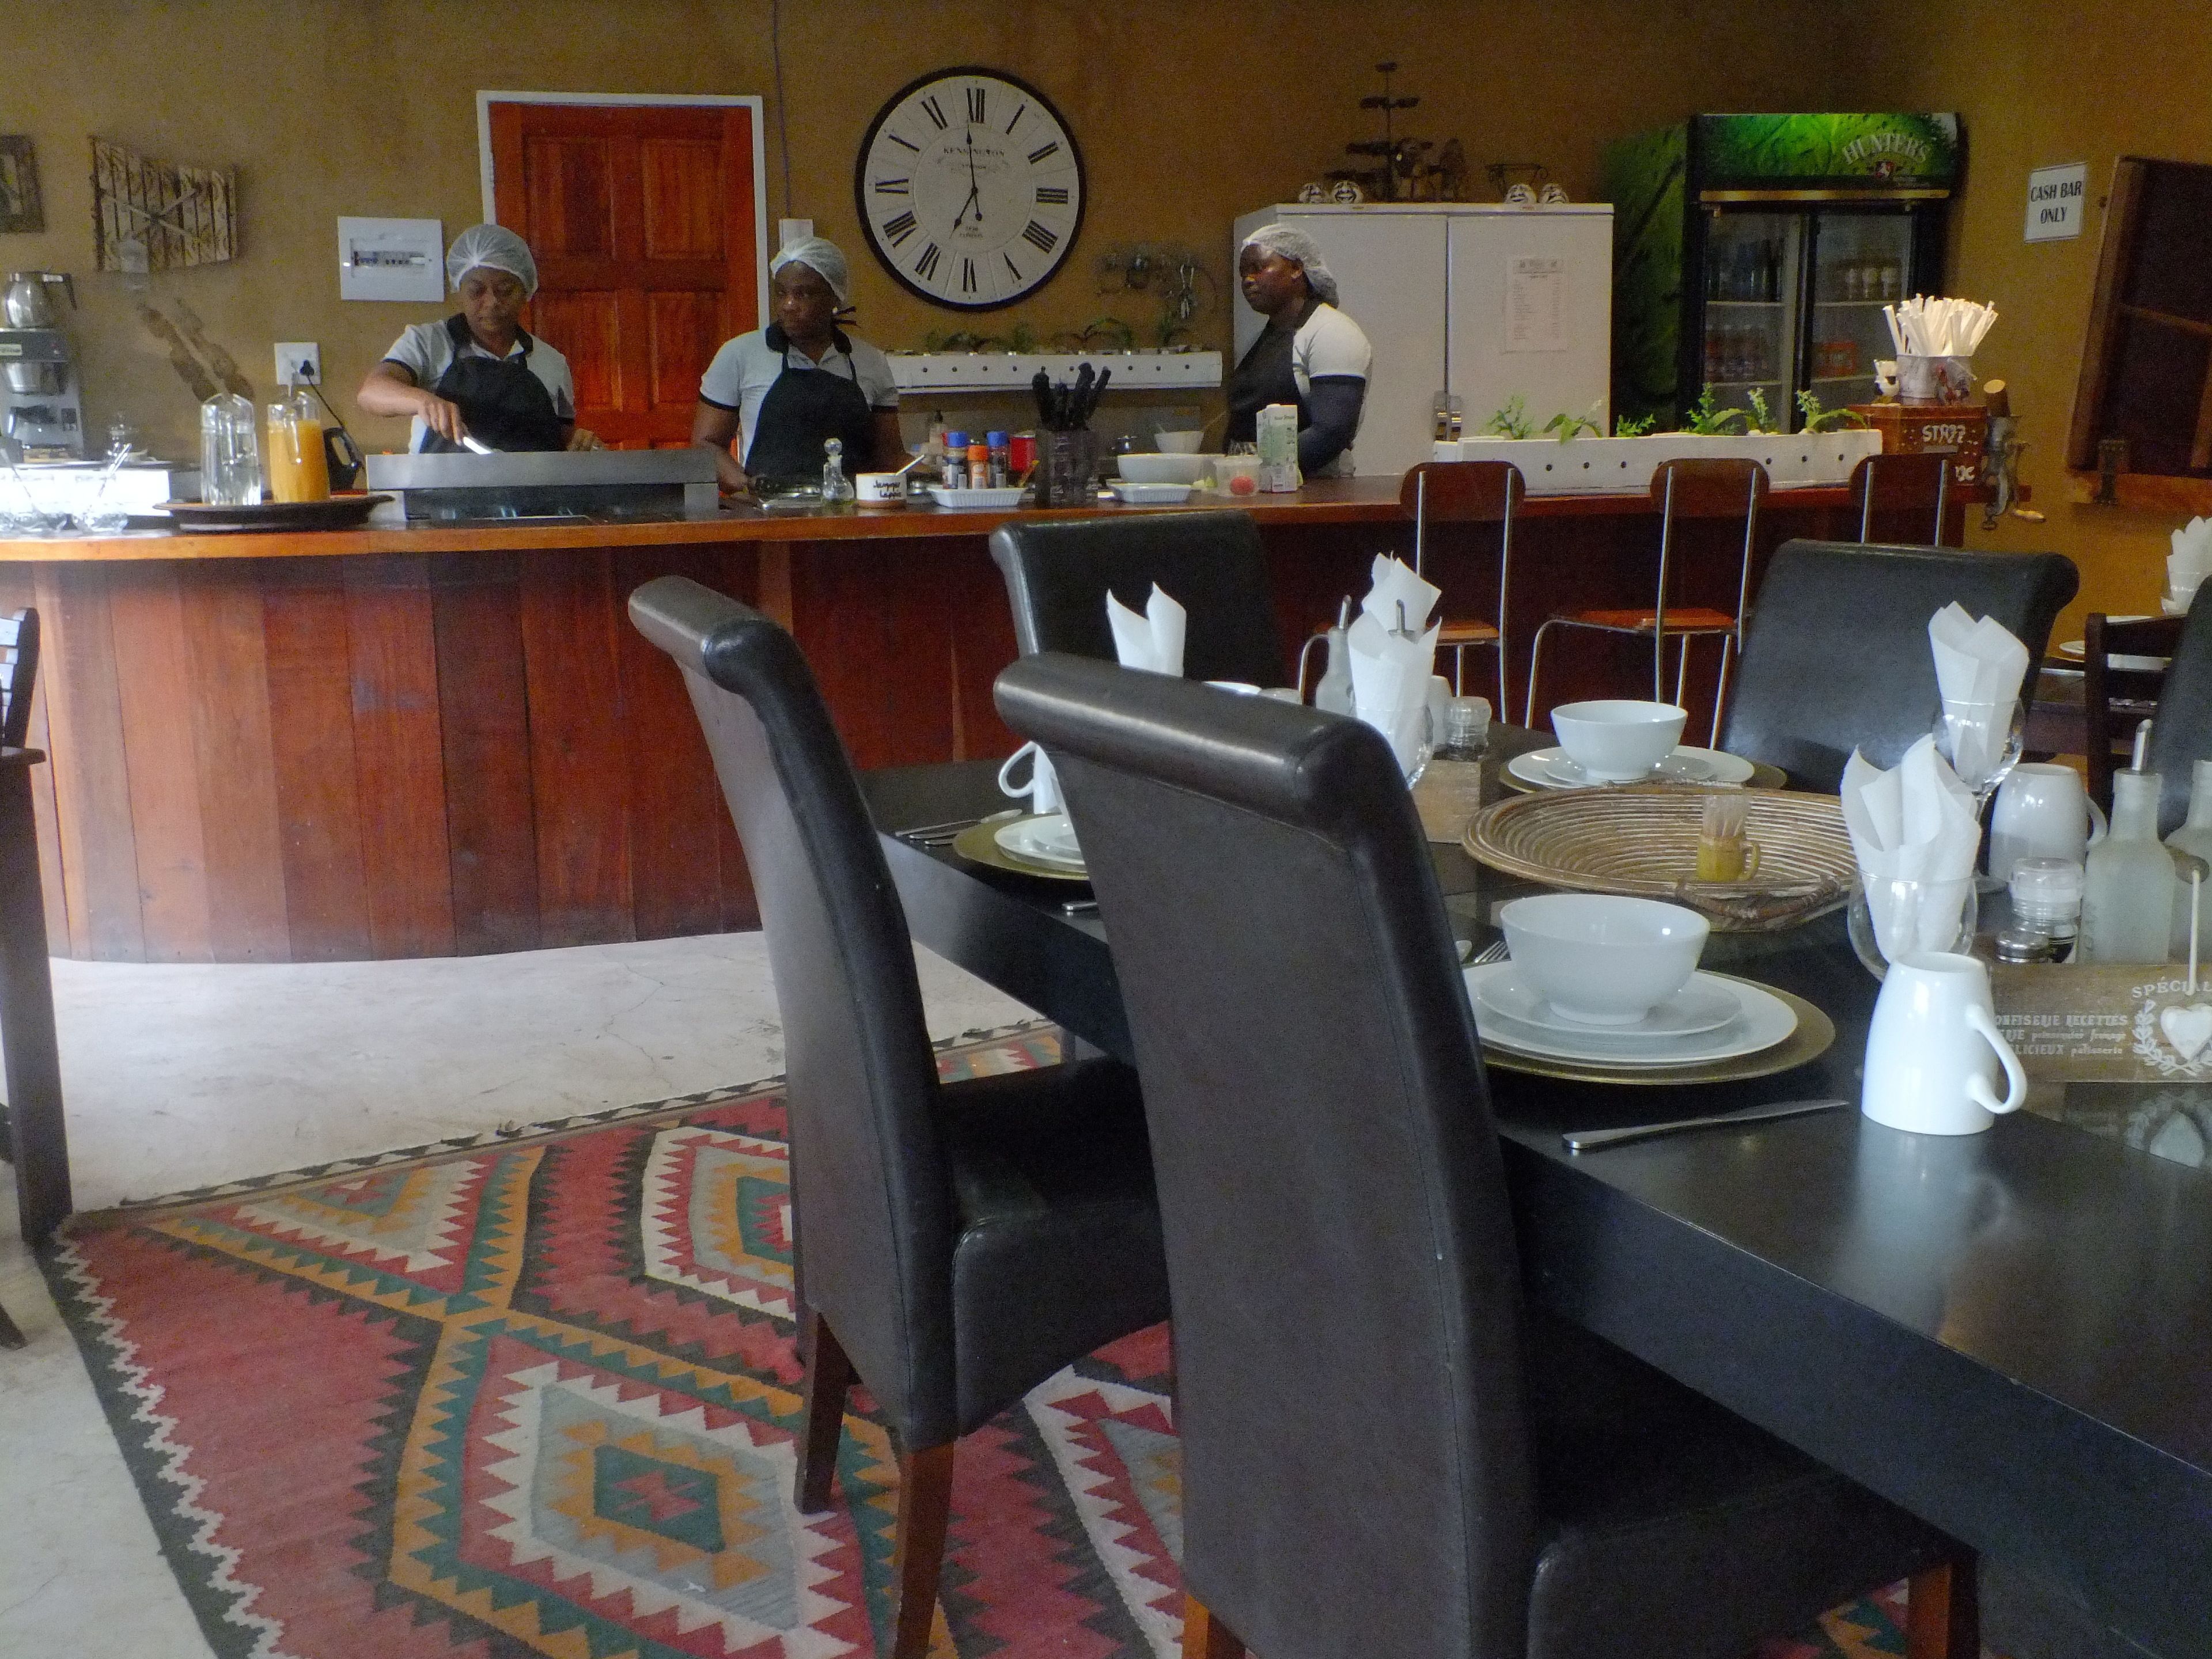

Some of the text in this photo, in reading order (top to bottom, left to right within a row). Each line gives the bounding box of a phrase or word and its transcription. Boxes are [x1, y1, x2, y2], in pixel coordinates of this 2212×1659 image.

[944, 146, 1005, 157] KENSNGTON
[2031, 180, 2083, 202] CASH BAR
[2040, 207, 2067, 224] ONLY
[2131, 976, 2212, 998] SPÉCIL
